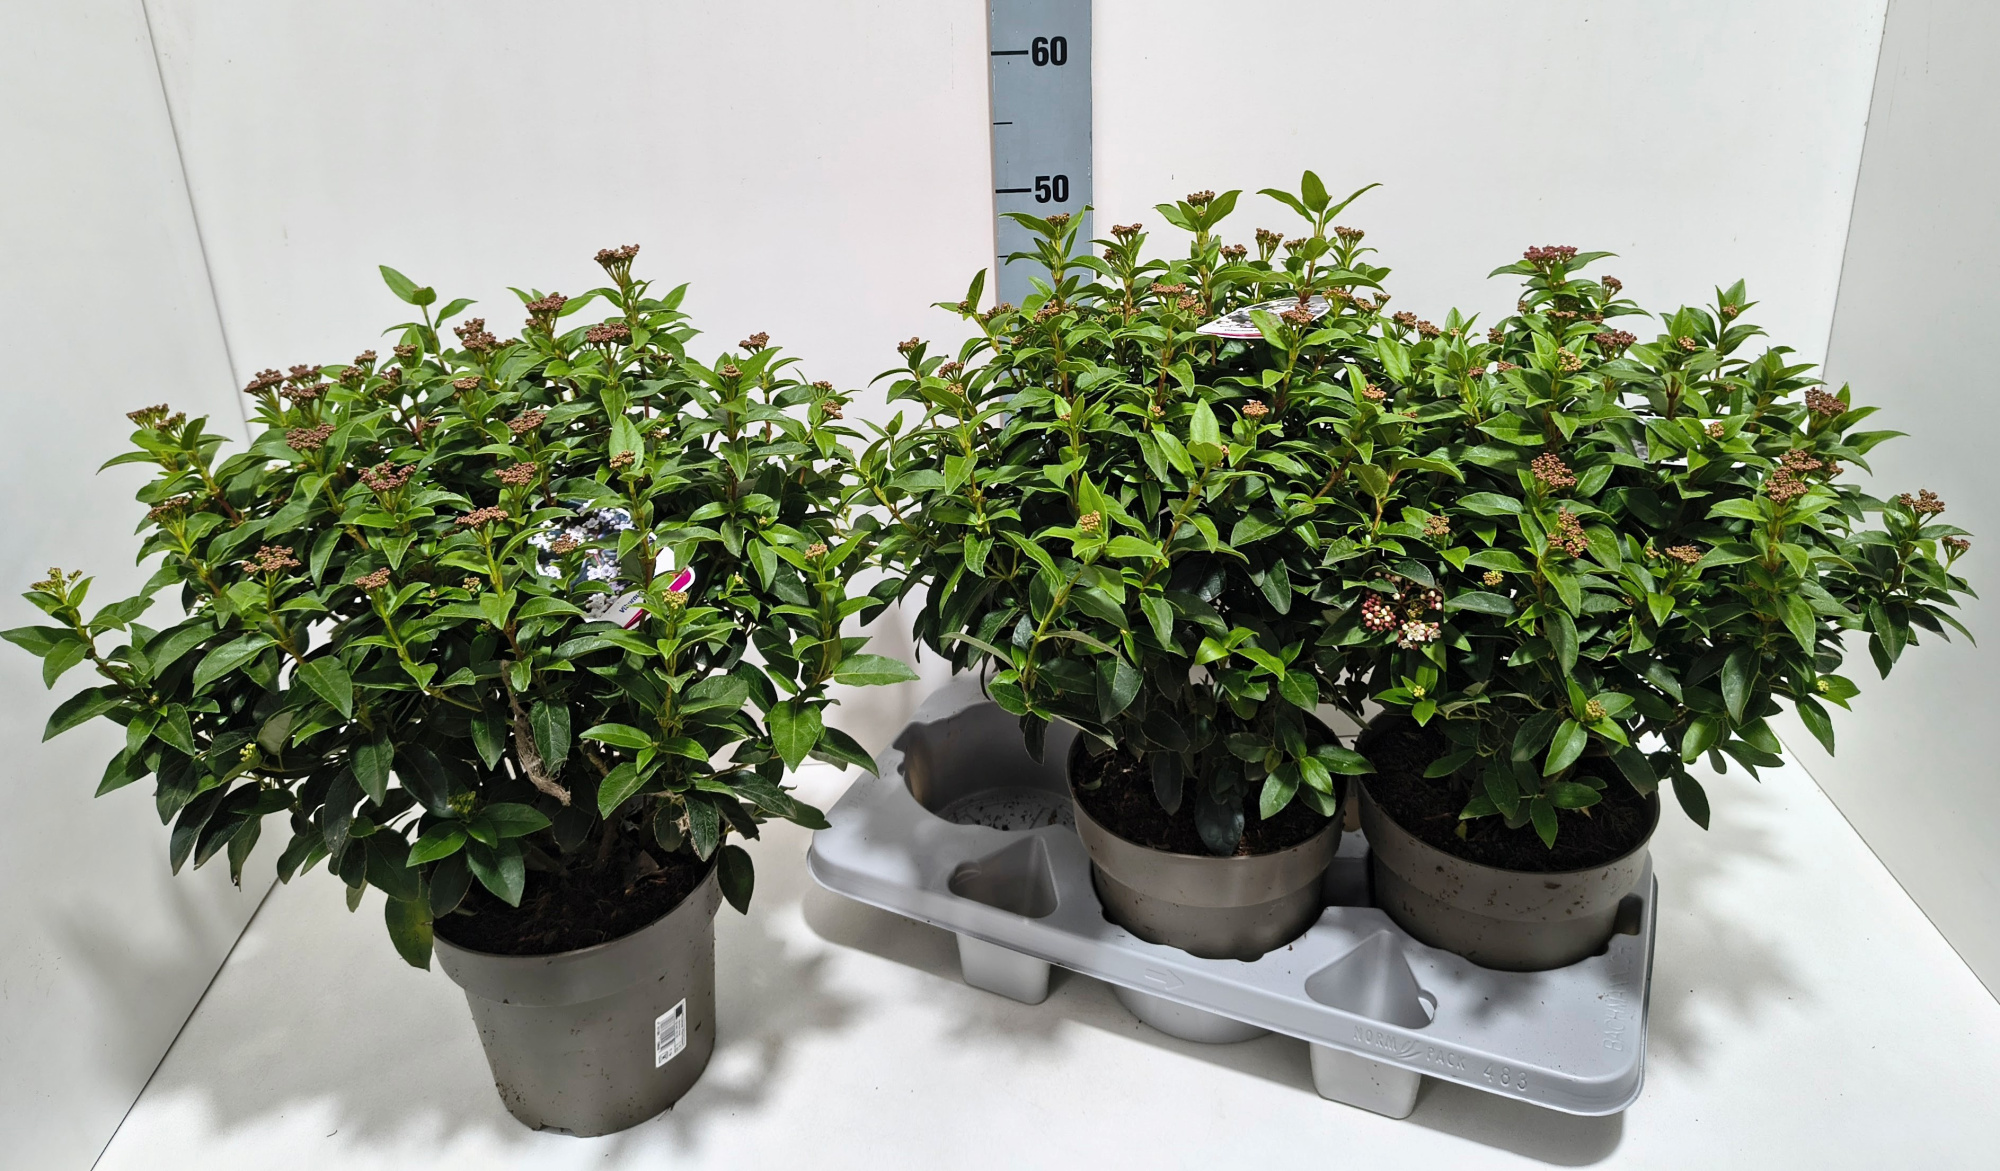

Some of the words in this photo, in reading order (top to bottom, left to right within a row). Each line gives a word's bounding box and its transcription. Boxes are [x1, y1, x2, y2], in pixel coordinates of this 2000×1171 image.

[1031, 36, 1068, 67] 60
[1034, 174, 1070, 204] 50
[1353, 1025, 1398, 1053] NORM
[1425, 1046, 1467, 1072] PACK
[1482, 1062, 1529, 1092] 483
